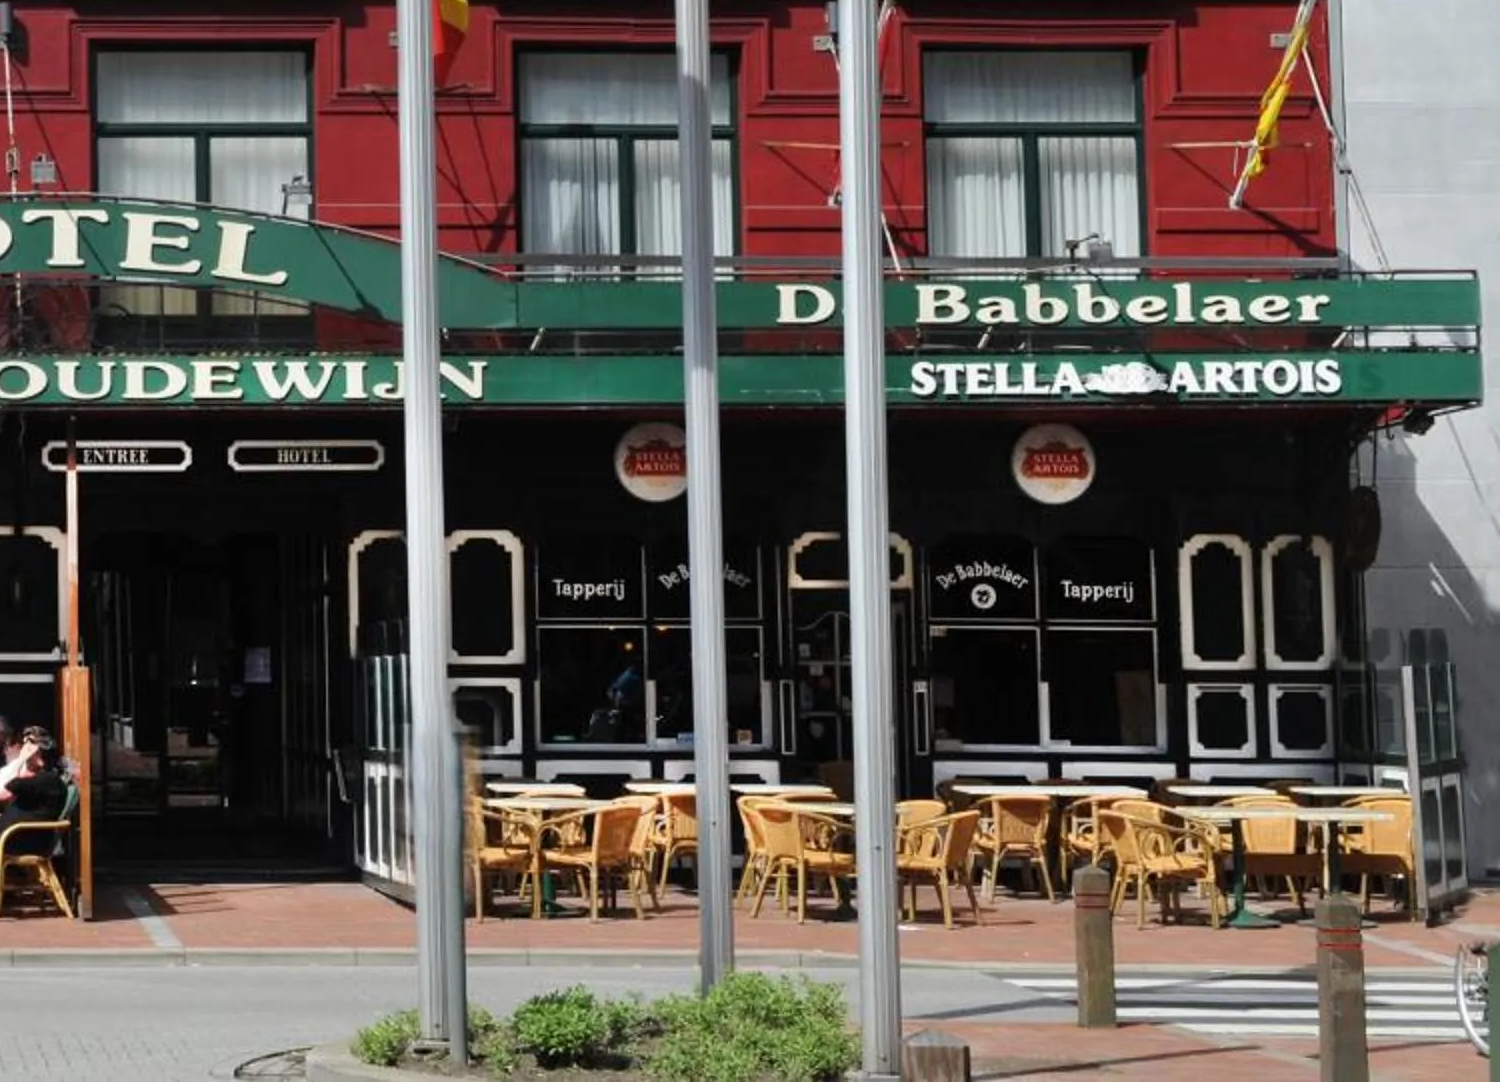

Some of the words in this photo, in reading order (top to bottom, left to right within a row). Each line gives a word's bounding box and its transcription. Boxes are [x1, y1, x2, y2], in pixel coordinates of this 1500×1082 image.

[776, 284, 837, 324] D
[915, 282, 1330, 324] Babbelaer
[911, 361, 1088, 396] STELLA
[1169, 359, 1342, 395] ARTOIS
[83, 449, 150, 465] ENTREE
[277, 448, 333, 465] HOTEL
[635, 451, 680, 461] STELLA
[1032, 453, 1079, 463] STELLA
[635, 462, 680, 472] ARTOIS
[1032, 463, 1080, 474] ARTOIS
[658, 572, 680, 590] De
[936, 573, 957, 590] De
[955, 560, 1029, 589] Babbelaer
[552, 579, 626, 601] Tapperij
[1060, 579, 1135, 603] Tapperij
